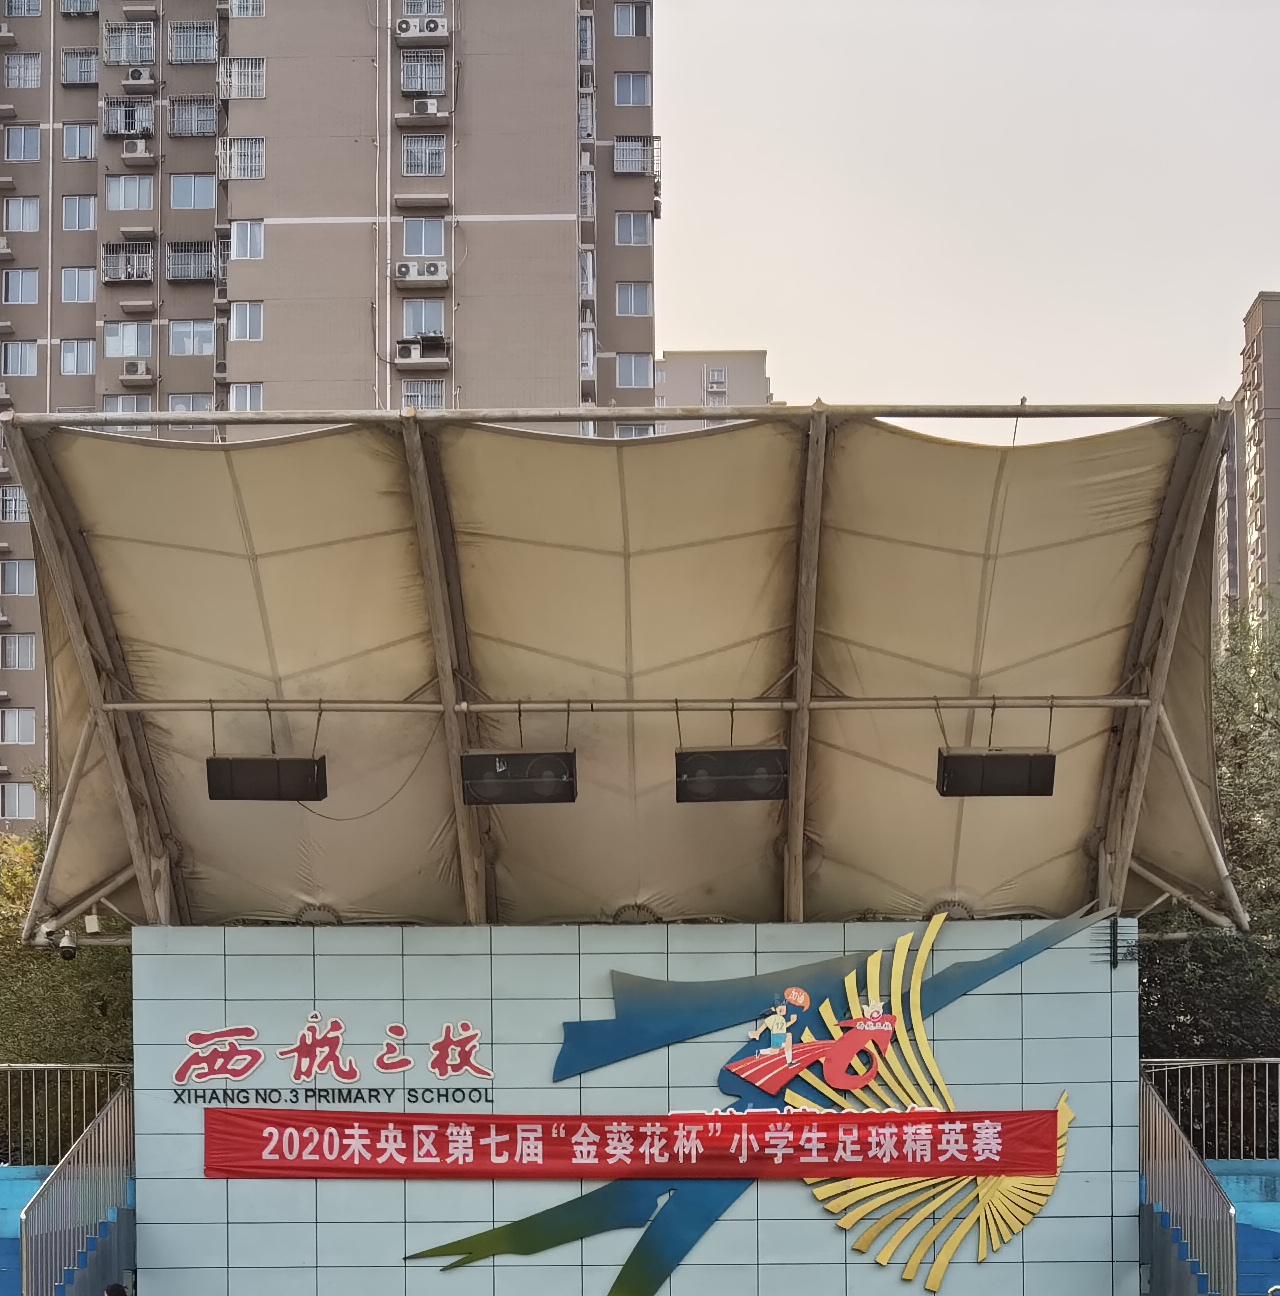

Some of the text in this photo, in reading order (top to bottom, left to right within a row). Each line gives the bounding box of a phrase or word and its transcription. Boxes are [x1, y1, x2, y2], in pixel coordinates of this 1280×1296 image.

[173, 1088, 495, 1104] XIHANG NO.3 PRIMARY SCHOOL
